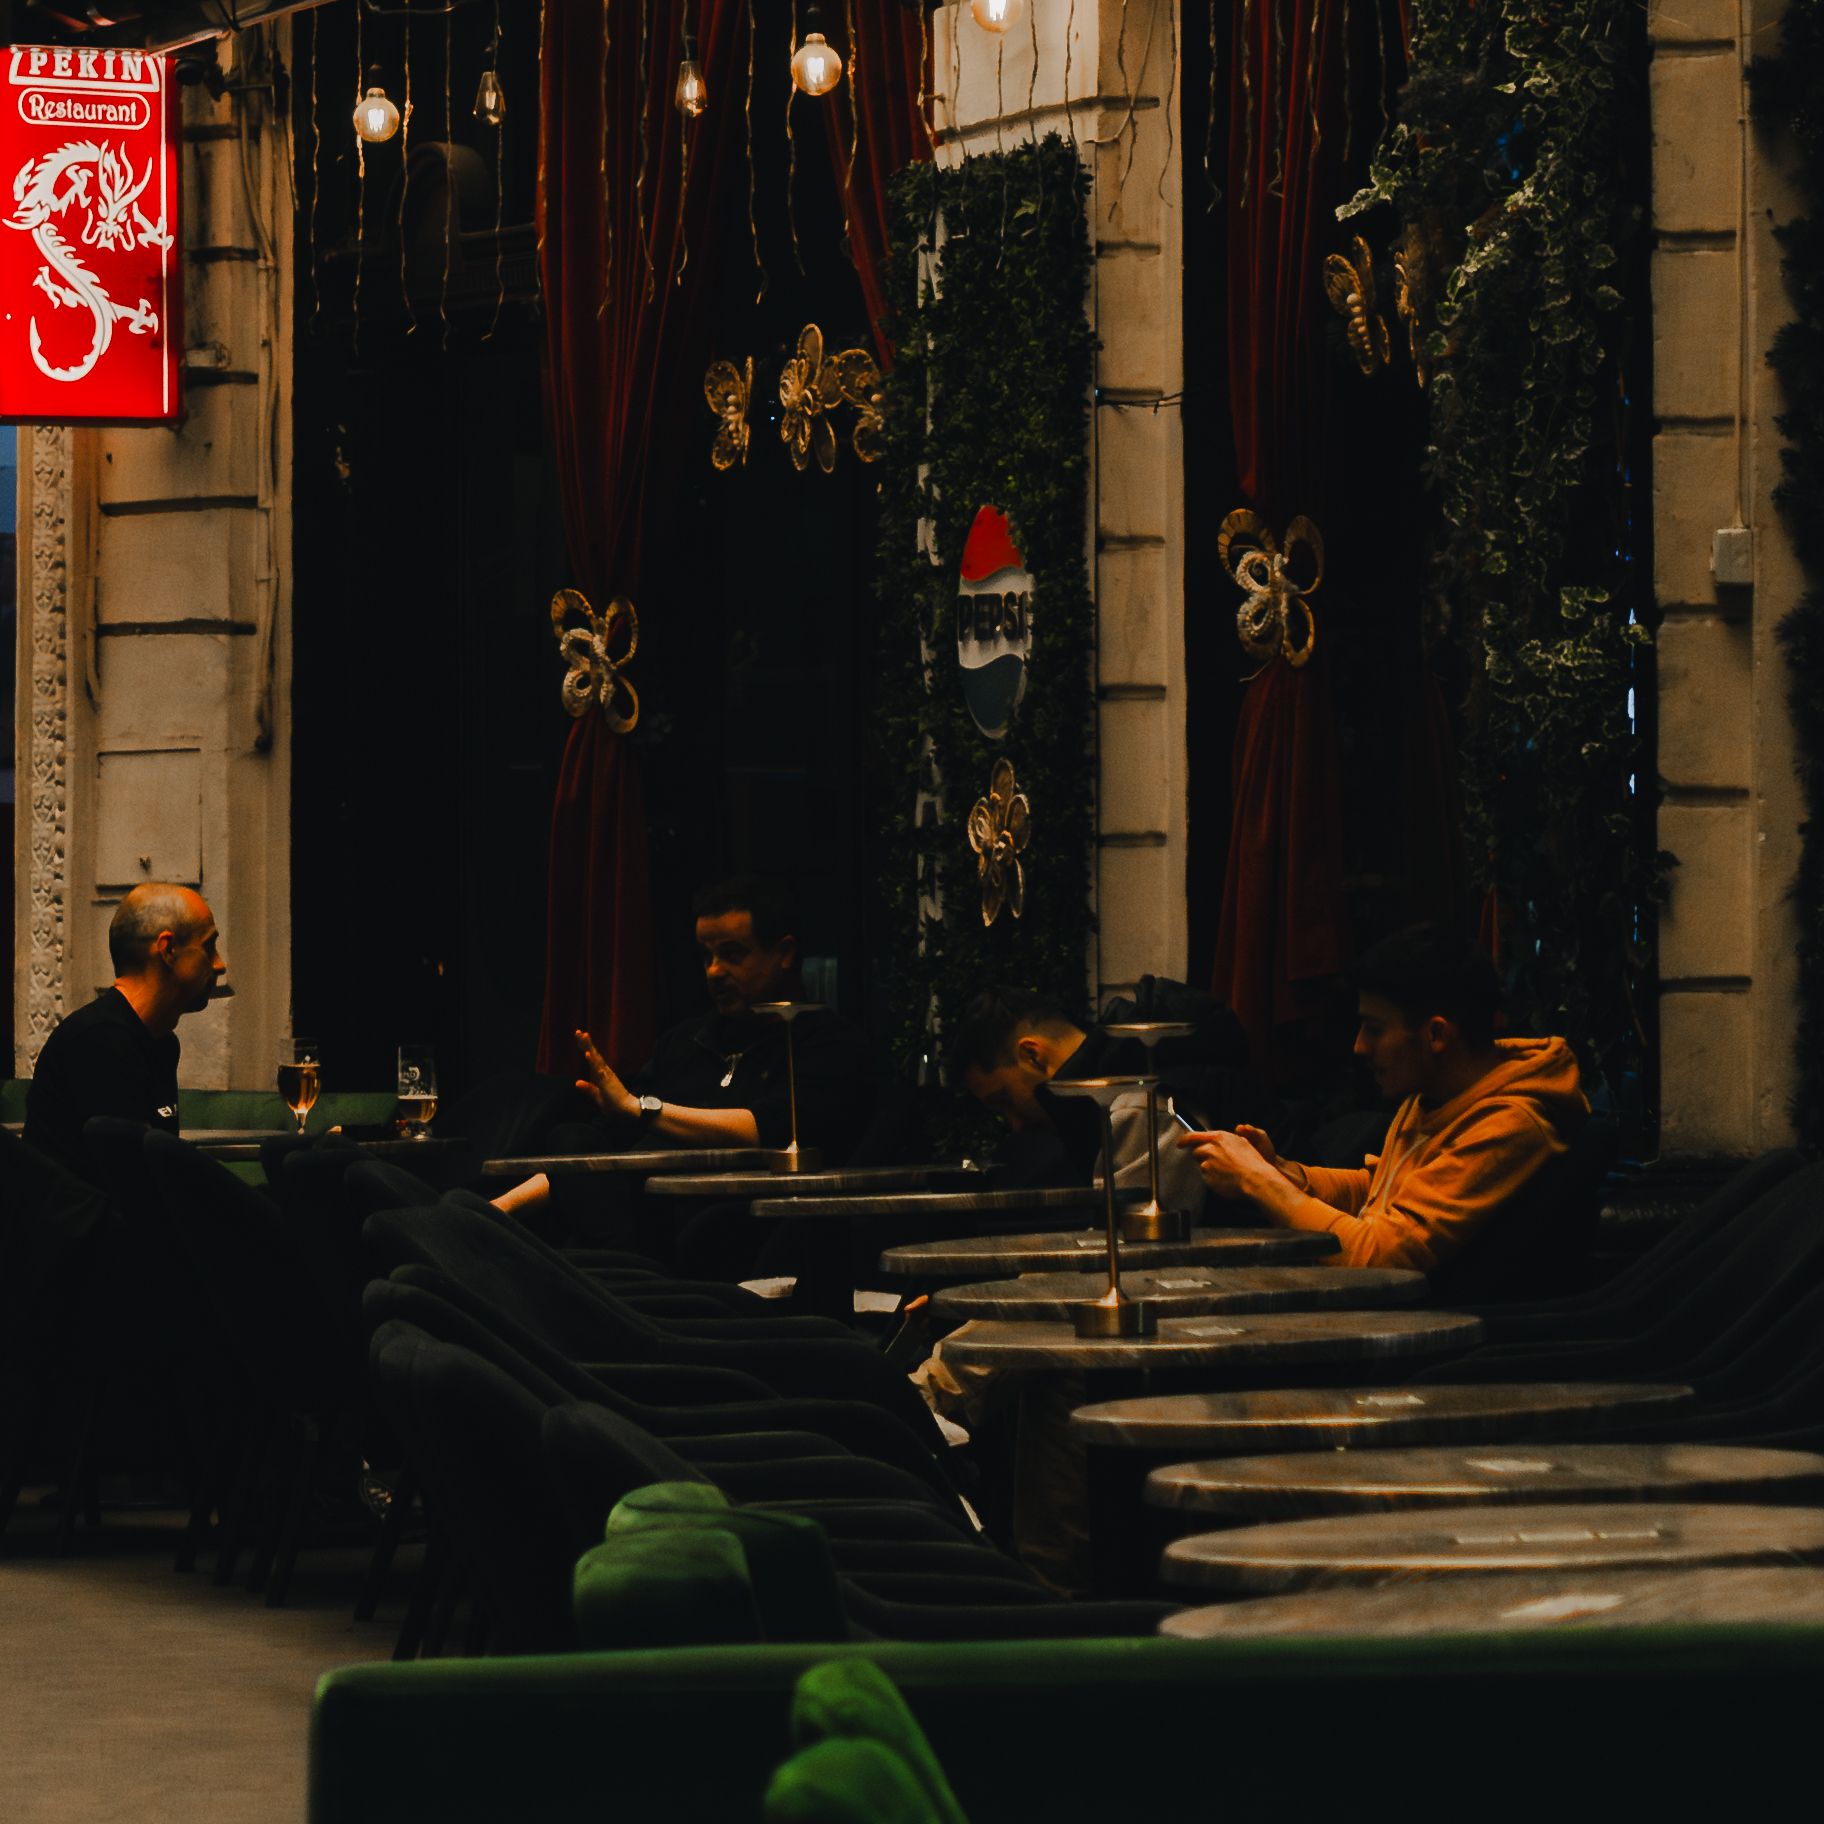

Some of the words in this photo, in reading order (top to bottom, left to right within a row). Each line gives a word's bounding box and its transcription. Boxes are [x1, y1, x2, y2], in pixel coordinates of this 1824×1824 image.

[28, 47, 144, 82] PEKIN
[28, 93, 138, 123] Restaurant
[957, 591, 1026, 643] PEPSI
